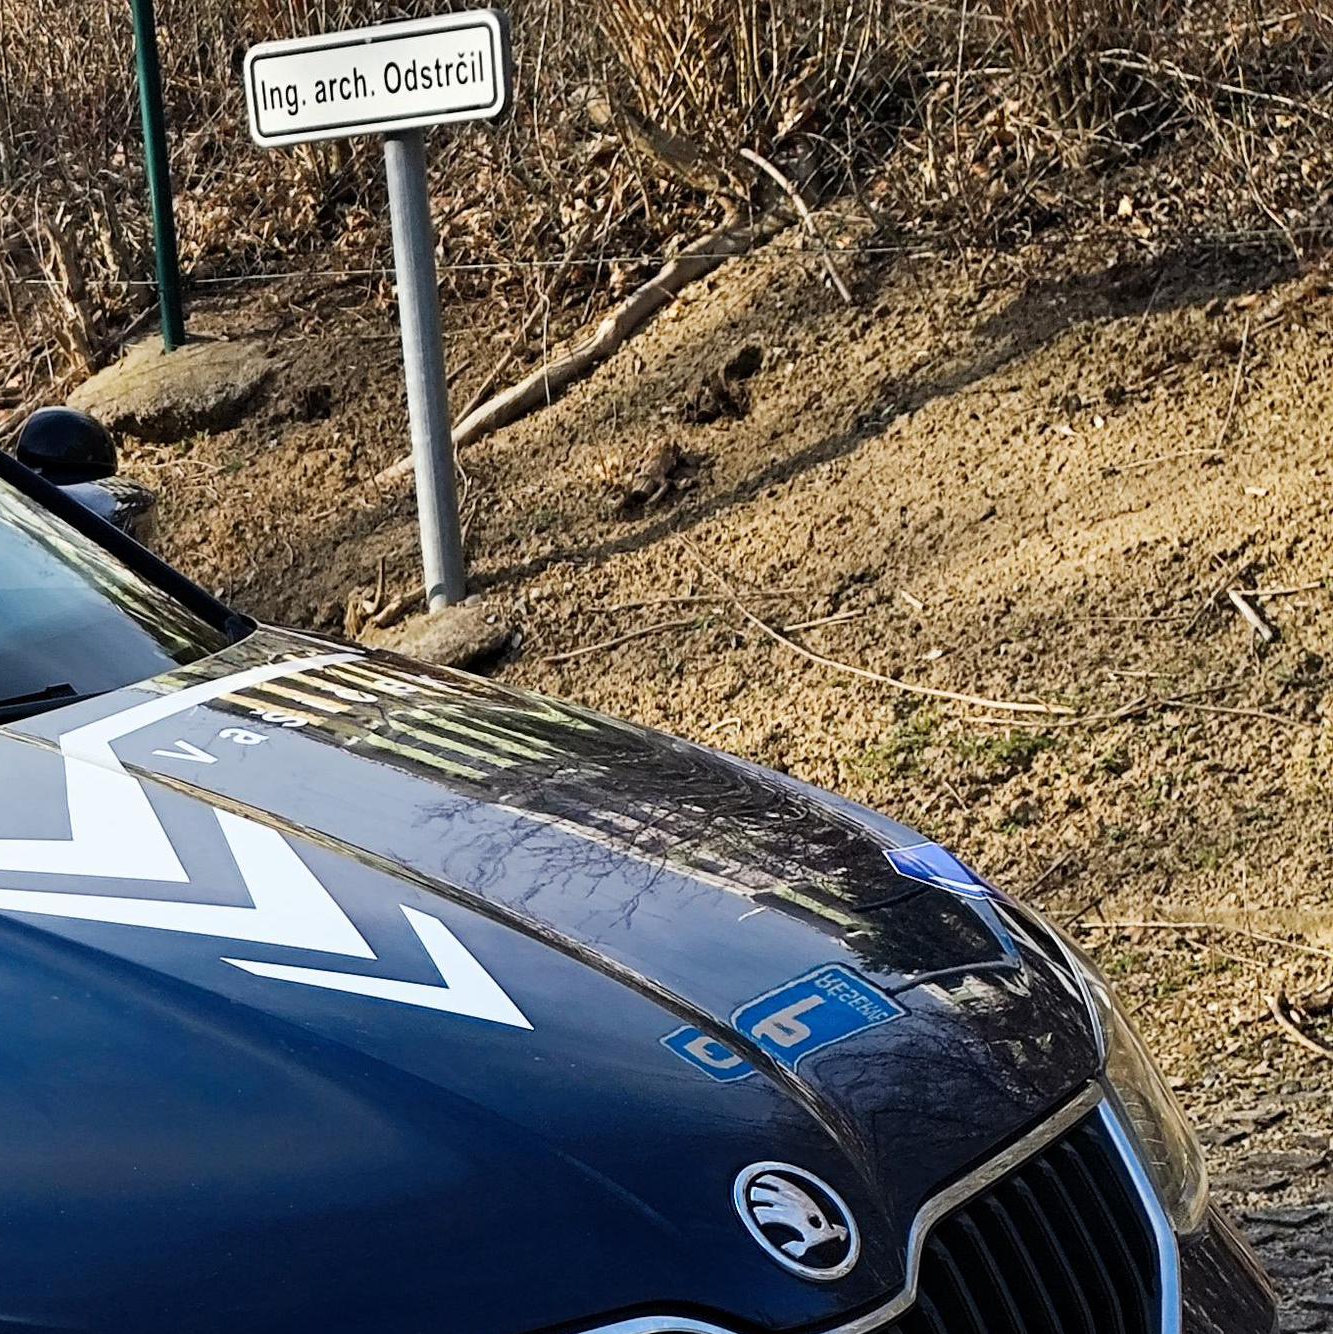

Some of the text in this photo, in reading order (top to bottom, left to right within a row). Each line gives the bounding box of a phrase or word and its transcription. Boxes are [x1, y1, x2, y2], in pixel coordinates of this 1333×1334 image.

[261, 50, 485, 116] Ing. arch. Odstrčil
